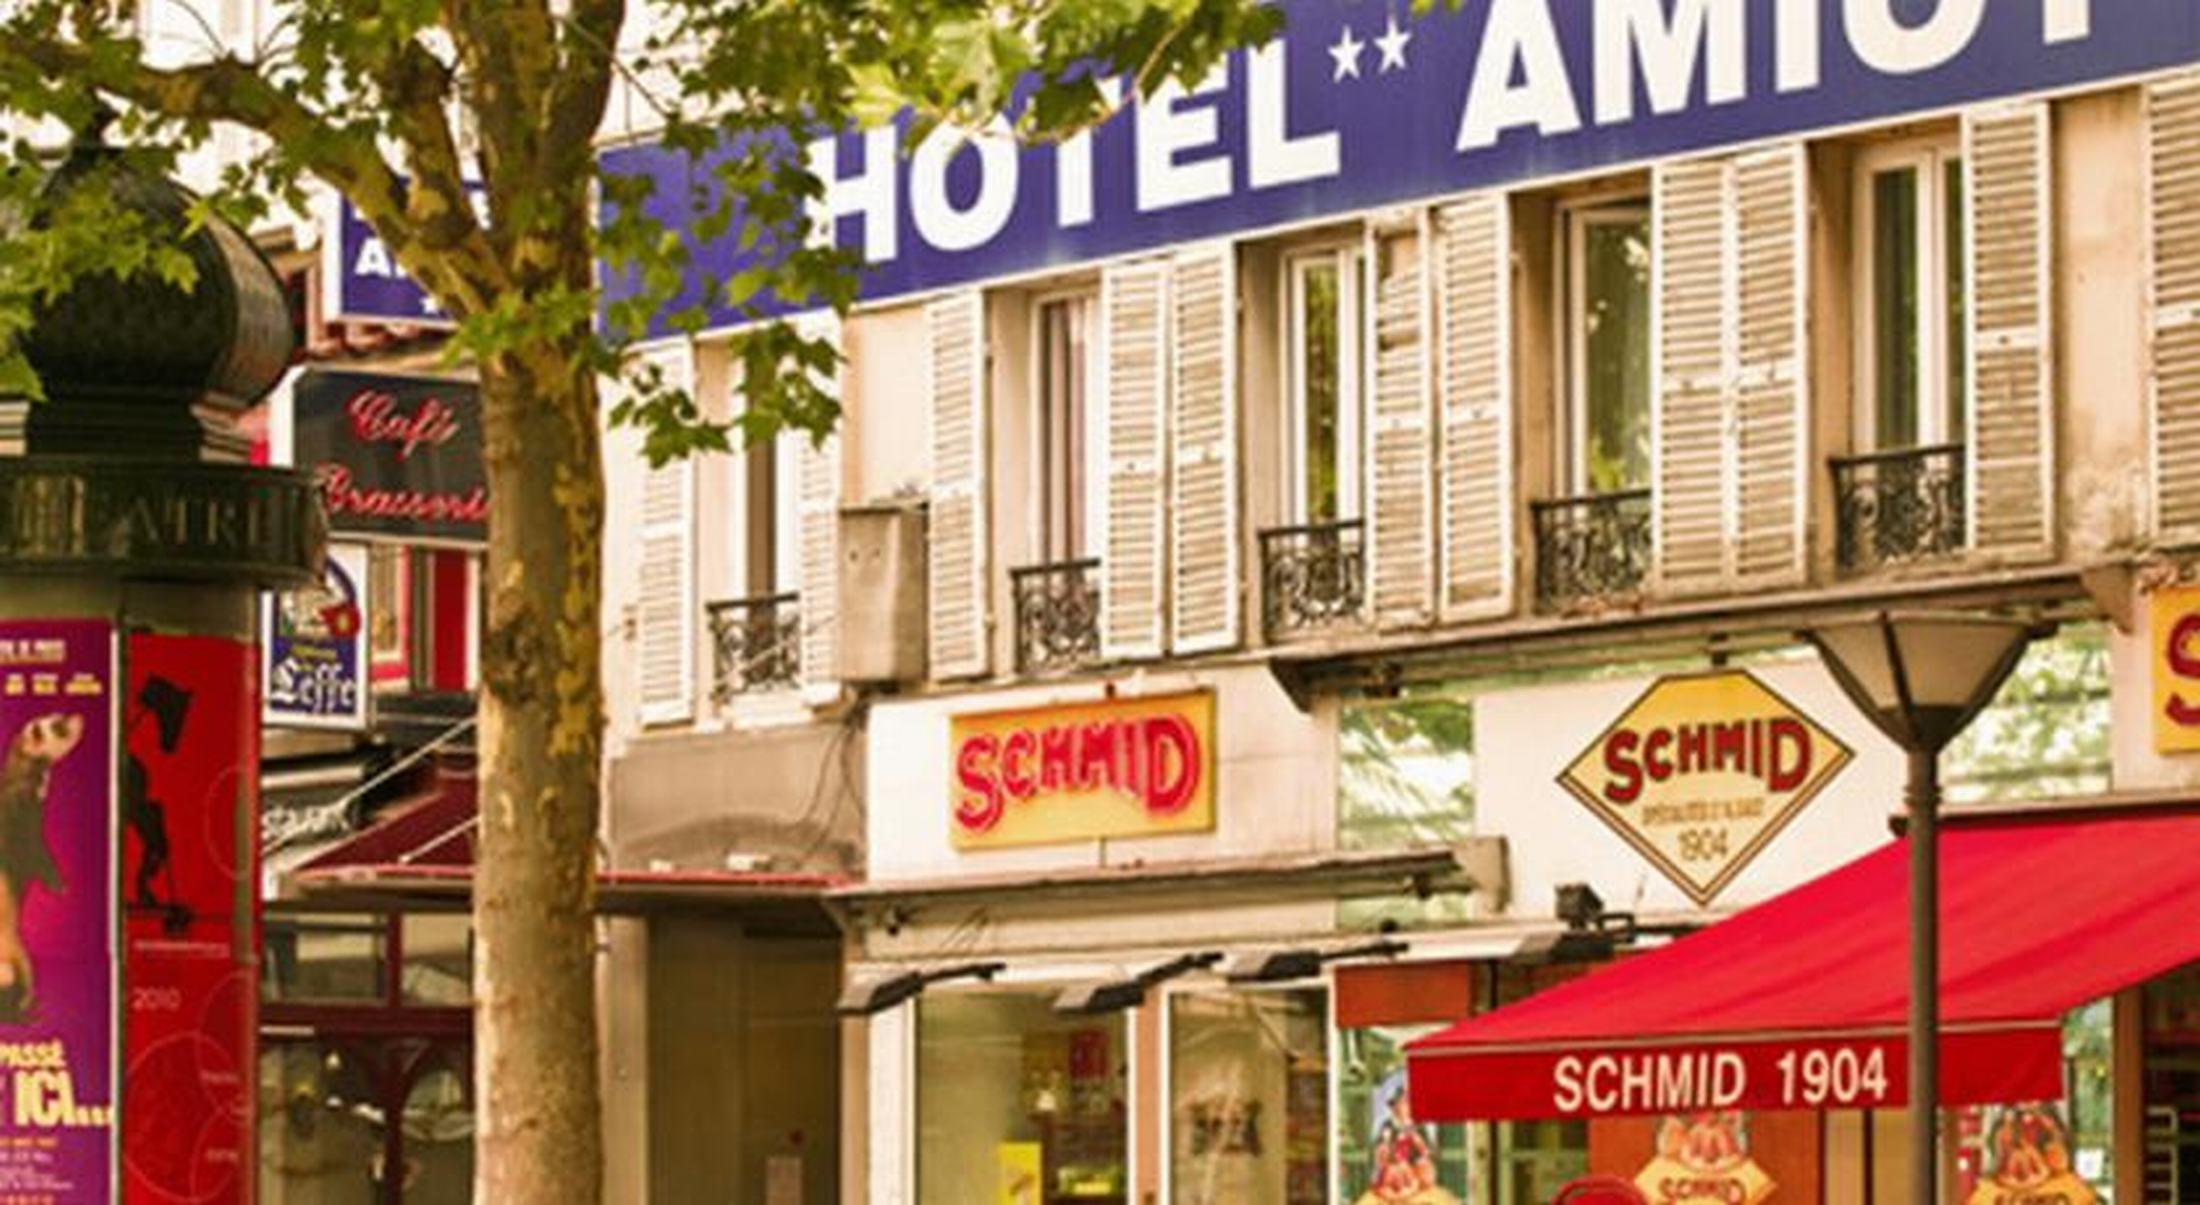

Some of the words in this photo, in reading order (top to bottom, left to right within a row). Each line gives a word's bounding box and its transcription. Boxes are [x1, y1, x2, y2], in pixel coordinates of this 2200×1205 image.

[1456, 0, 2091, 151] AMI
[272, 656, 356, 713] Leffe
[955, 714, 1201, 833] SCHMID
[1603, 717, 1812, 804] SCHMID
[1553, 1052, 1747, 1112] SCHMID
[1776, 1047, 1889, 1104] 1904
